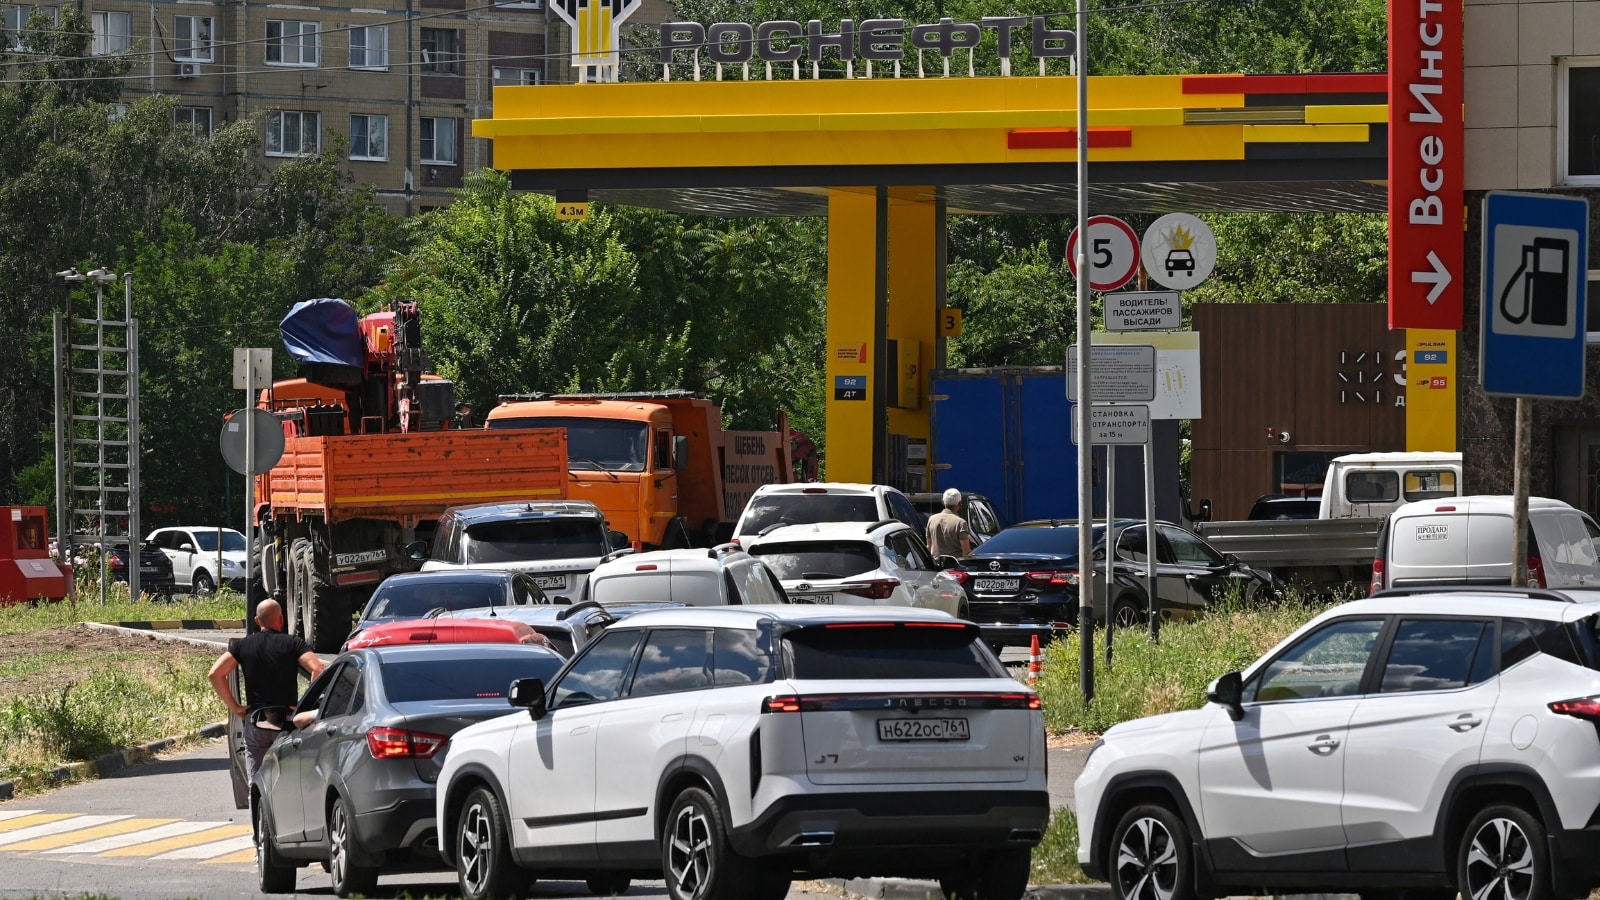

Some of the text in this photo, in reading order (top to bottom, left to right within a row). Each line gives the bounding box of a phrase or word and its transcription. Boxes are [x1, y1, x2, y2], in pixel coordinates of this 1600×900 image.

[660, 17, 1077, 63] РОСНЕФТЬ
[1409, 136, 1444, 225] Все
[1093, 239, 1113, 268] 5
[1120, 298, 1167, 307] ВОДИТЕЛЬ!
[1113, 308, 1173, 316] ПАССАЖИРОВ
[946, 316, 955, 330] 3
[1124, 318, 1161, 326] ВЫСАДИ
[844, 390, 857, 398] ДТ
[1092, 420, 1147, 428] ОТРАНСПОРТА
[735, 436, 766, 456] ЩЕБЕНЬ
[725, 464, 750, 484] ПЕСОК
[550, 576, 563, 584] 761
[816, 595, 831, 604] 761
[884, 720, 965, 738] Н622ОС 761
[814, 754, 839, 764] J7
